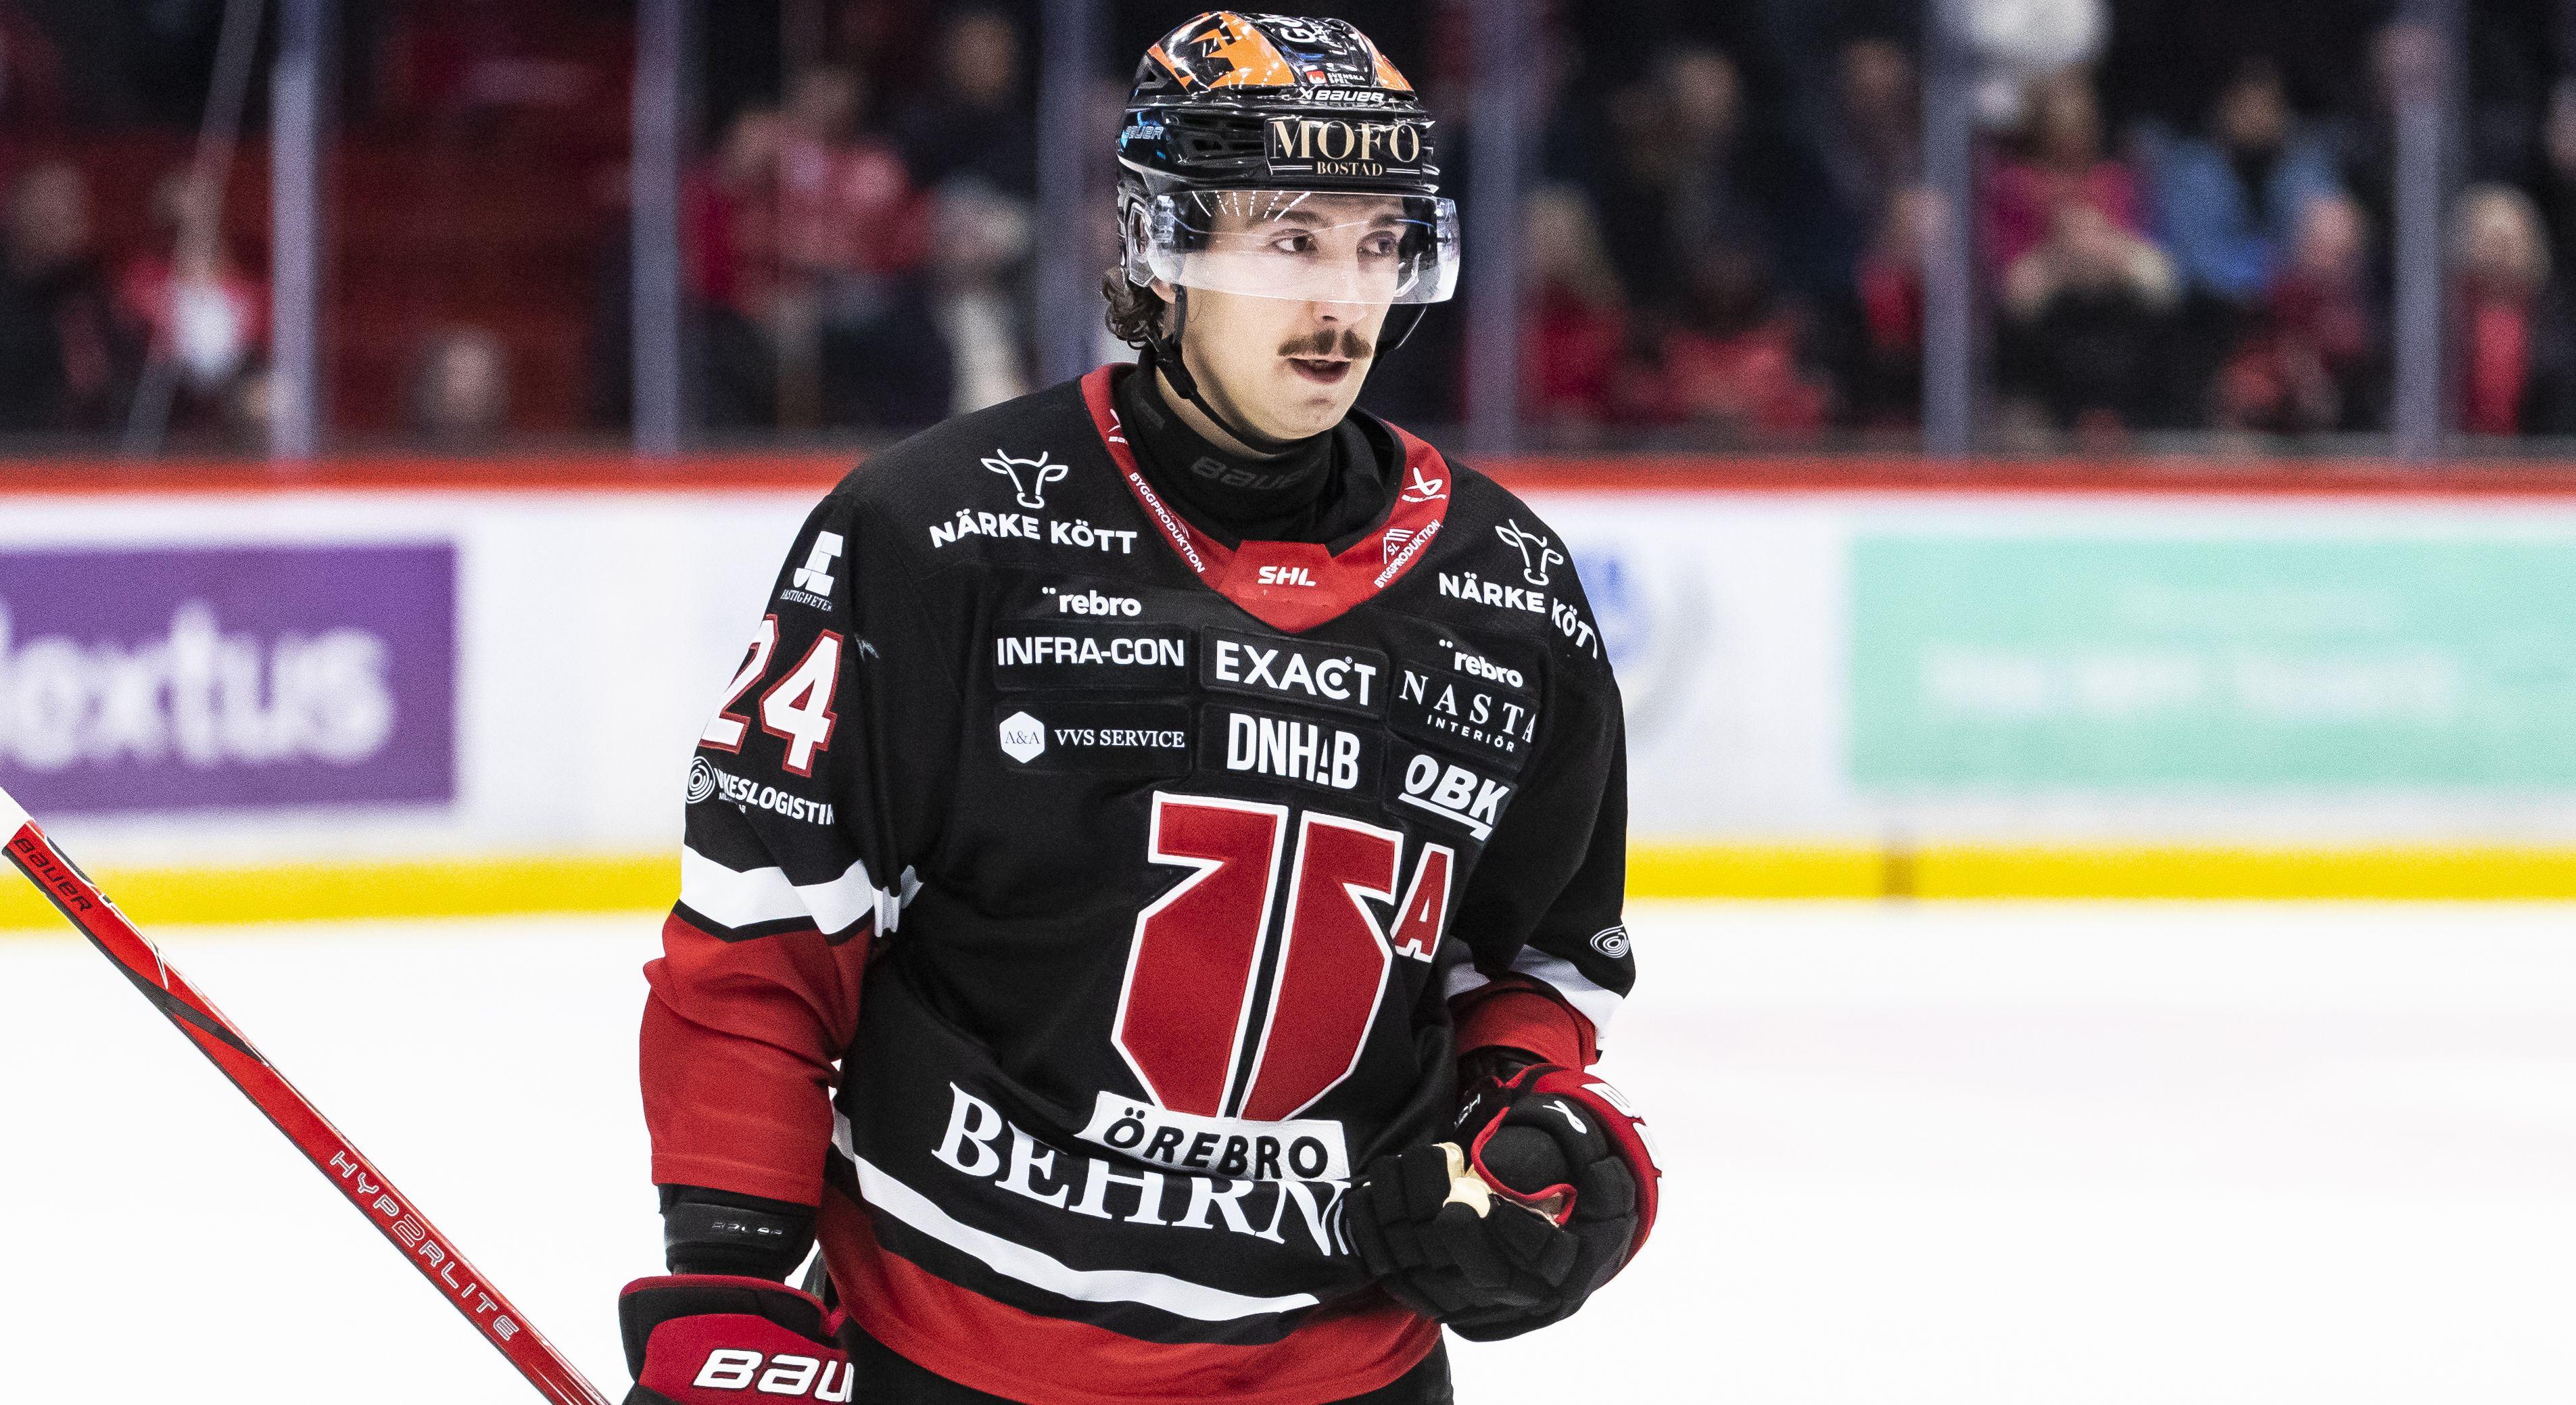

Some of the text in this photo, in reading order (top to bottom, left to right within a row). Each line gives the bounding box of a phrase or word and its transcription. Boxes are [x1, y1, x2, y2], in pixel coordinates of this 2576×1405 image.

[1269, 120, 1419, 163] MOFO
[1317, 162, 1383, 176] BOSTAD
[929, 508, 1137, 554] NÄRKE KÖTT
[1129, 472, 1206, 574] BYGGPRODUKTION
[1373, 519, 1441, 589] BYGGPRODUKTION
[1387, 542, 1400, 556] SL
[1258, 566, 1316, 587] SHL
[1439, 571, 1546, 614] NÄRKE
[0, 597, 398, 769] extus
[997, 636, 1185, 667] INFRA-CON
[1216, 640, 1377, 707] EXACT
[698, 613, 844, 778] 24
[1398, 669, 1537, 744] NASTA
[1005, 729, 1185, 748] A&A VVS SERVICE
[1427, 715, 1515, 753] INTERIÖR
[1405, 754, 1510, 826] OBK
[1389, 842, 1454, 963] A
[1103, 1107, 1329, 1180] ÖREBRO
[329, 1151, 519, 1341] HYP2RLITE
